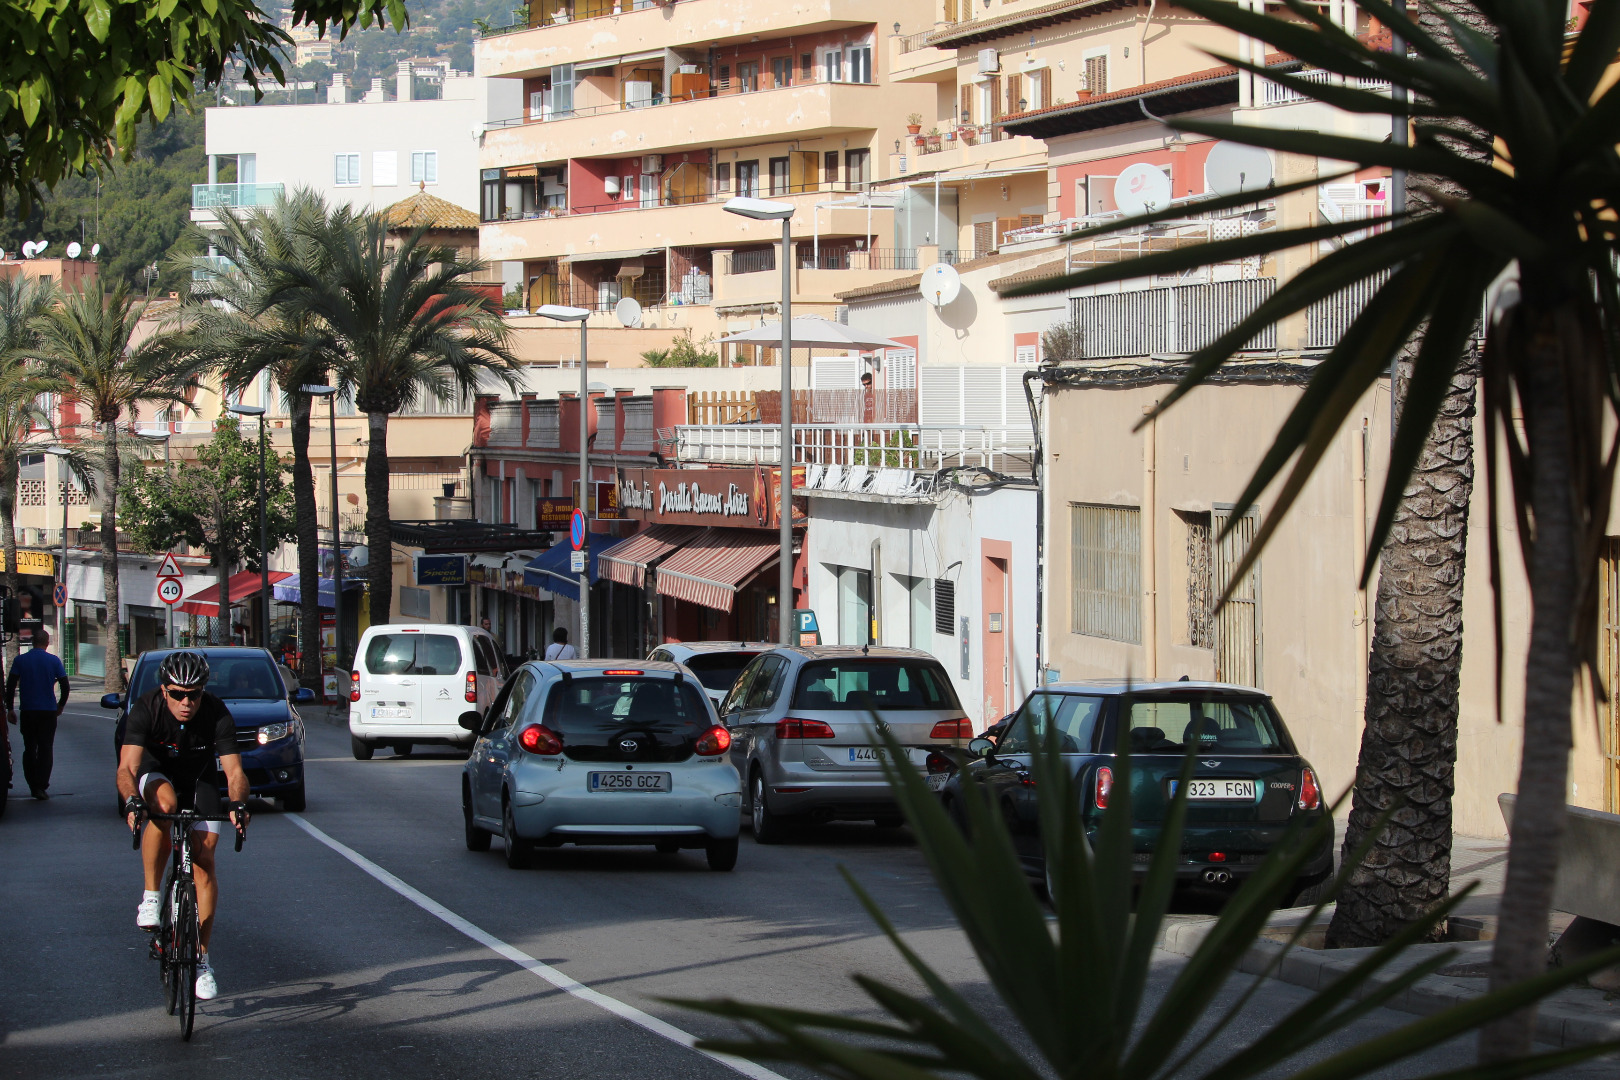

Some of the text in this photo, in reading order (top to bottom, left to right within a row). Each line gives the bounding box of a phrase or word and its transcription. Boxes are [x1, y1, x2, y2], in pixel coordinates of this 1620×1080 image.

[692, 481, 722, 514] Buenos
[723, 482, 749, 517] Aires
[541, 513, 571, 521] RESTAURA
[17, 551, 51, 568] ENTER
[163, 586, 178, 595] 40
[801, 613, 812, 630] P
[856, 749, 886, 760] 4406
[601, 775, 661, 788] 4256 GCZ
[1190, 782, 1252, 796] 323 FGN
